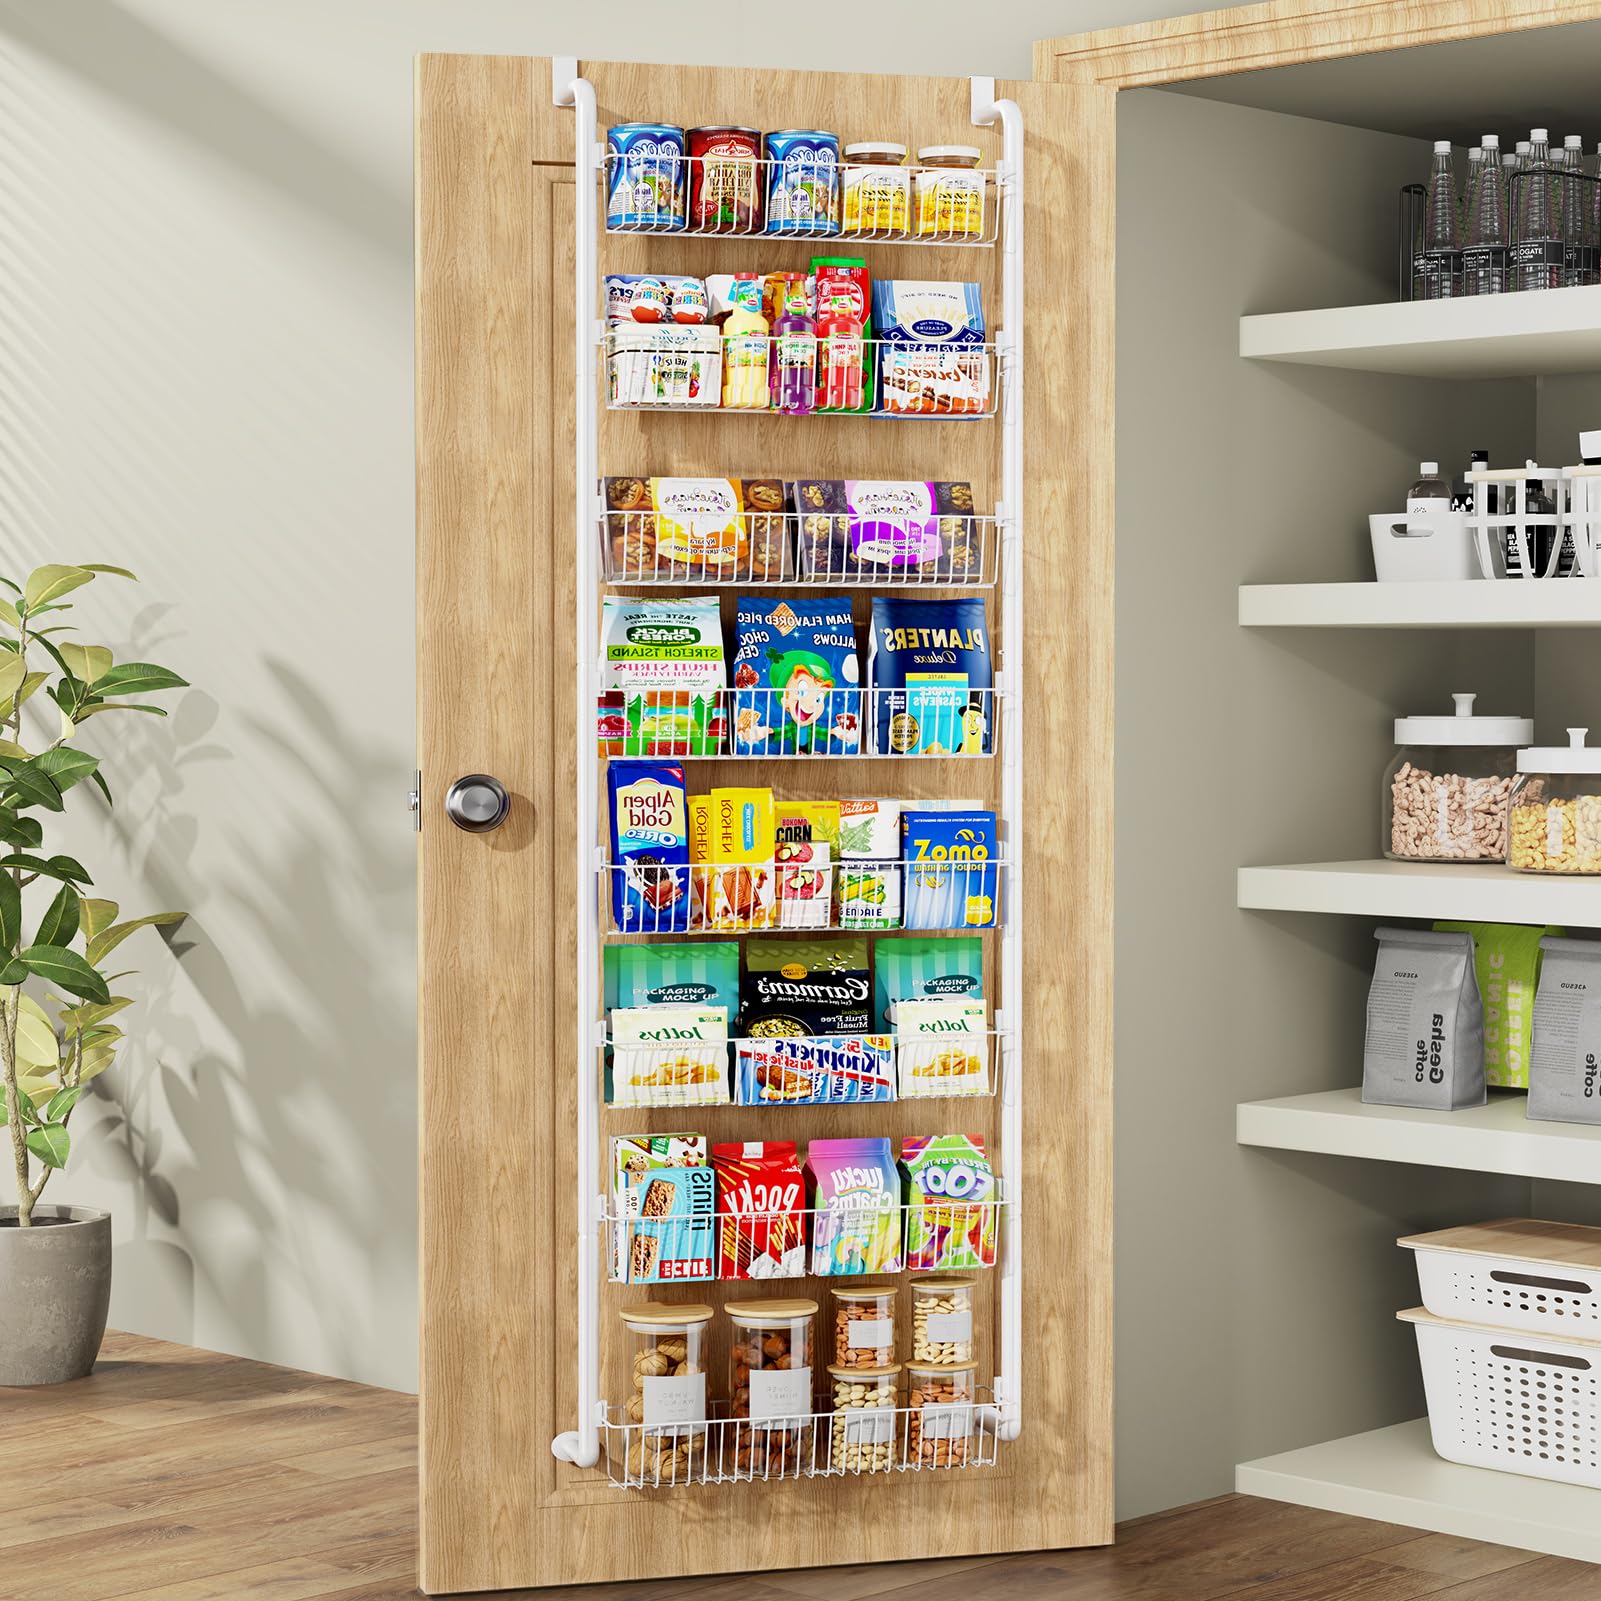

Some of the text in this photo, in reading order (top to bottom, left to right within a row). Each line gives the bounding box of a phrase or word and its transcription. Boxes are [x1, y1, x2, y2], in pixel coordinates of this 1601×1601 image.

[776, 825, 812, 843] CORN
[913, 839, 989, 863] Zomo
[632, 986, 707, 996] PACKAGING
[935, 985, 963, 993] MOCK
